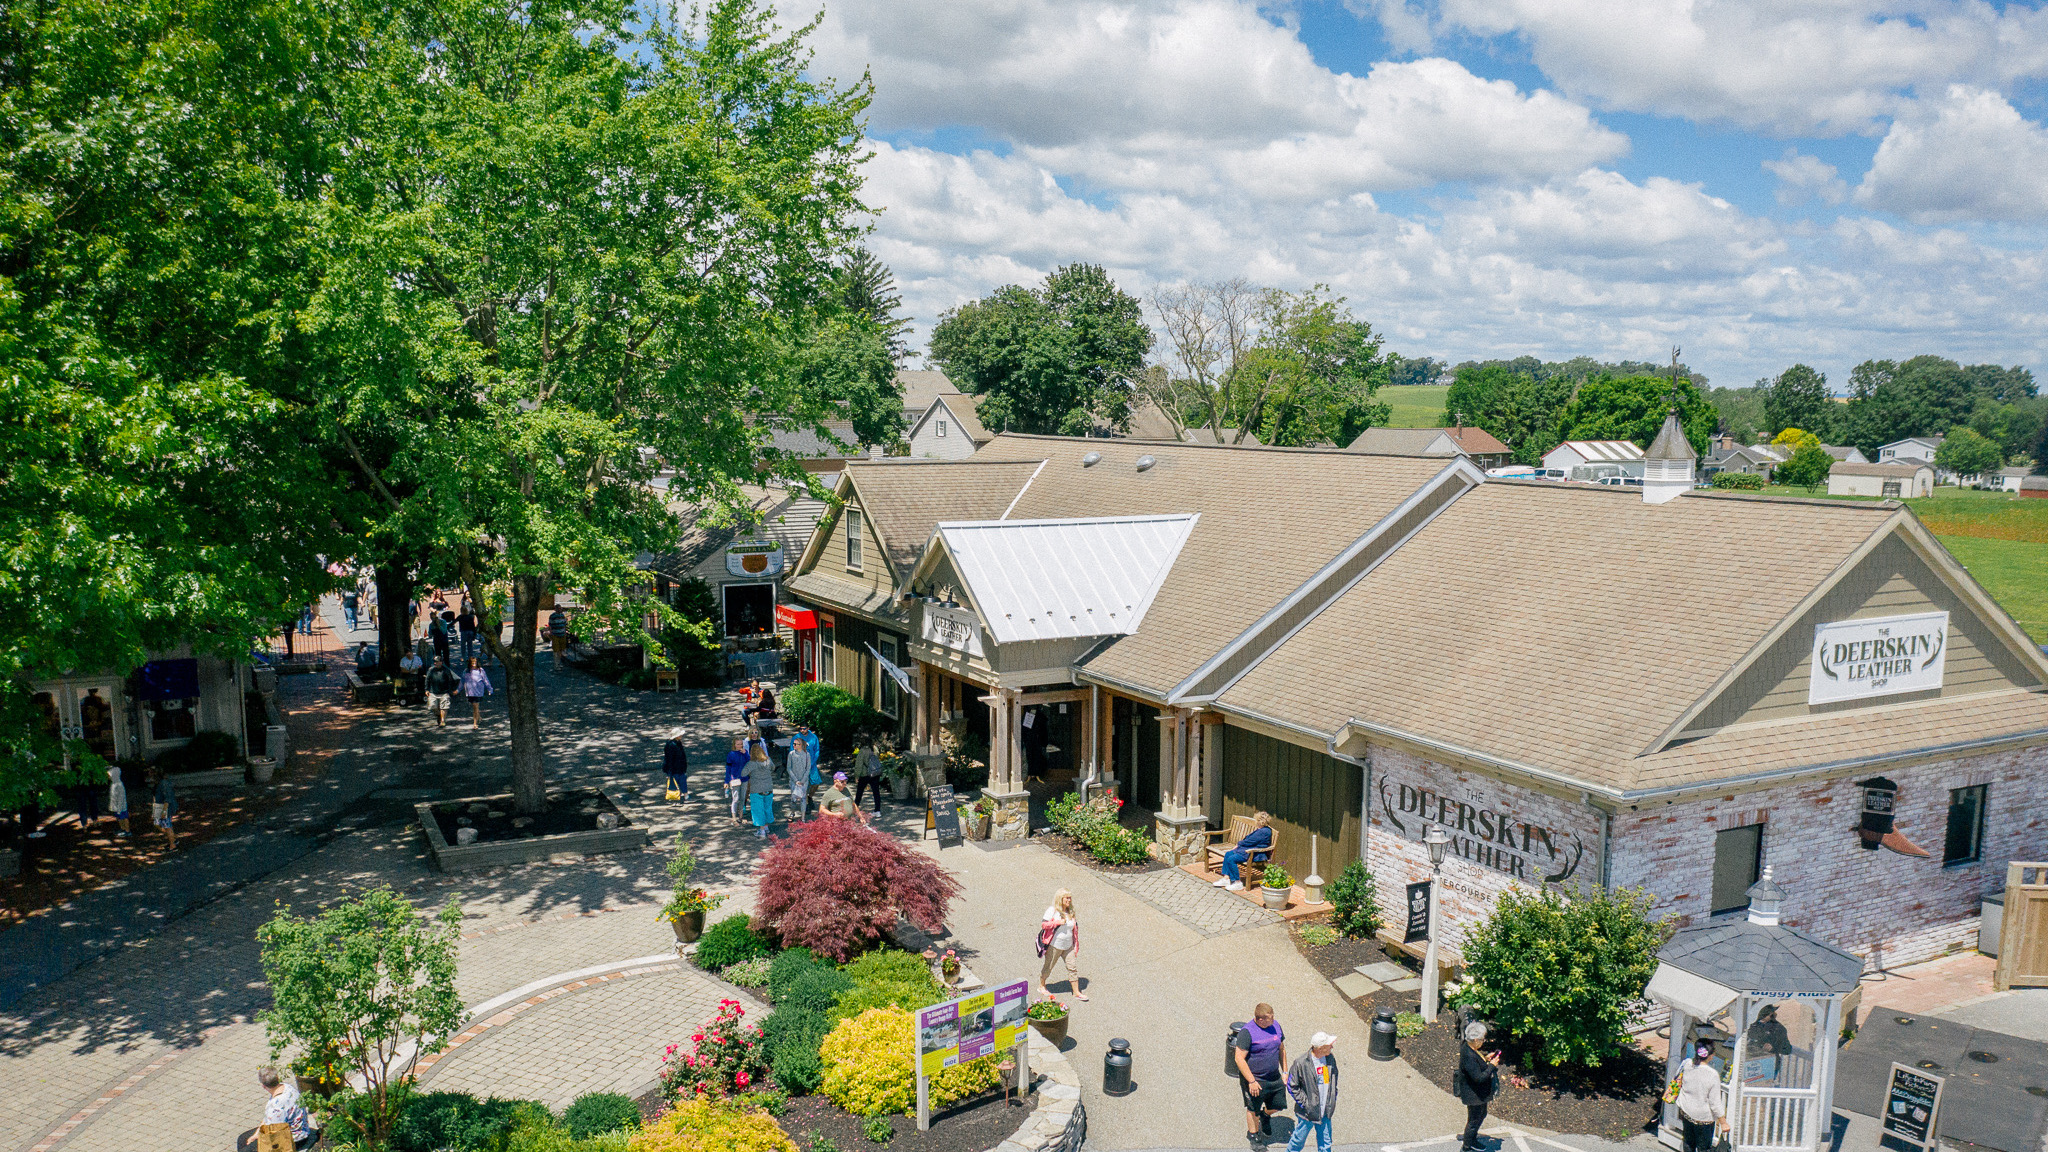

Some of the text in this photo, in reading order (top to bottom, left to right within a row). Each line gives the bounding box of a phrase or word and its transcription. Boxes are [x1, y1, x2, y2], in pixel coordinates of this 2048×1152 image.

[936, 616, 968, 635] DEERSKIN
[1878, 628, 1890, 636] THE
[941, 629, 962, 643] LEATHER
[1833, 634, 1931, 664] DEERSKIN
[1848, 659, 1912, 680] LEATHER
[1871, 678, 1887, 688] SHOP
[1466, 788, 1485, 804] THE
[1398, 783, 1557, 861] DEERSKIN
[1422, 823, 1525, 879] LATHER
[1458, 864, 1484, 879] SHOP
[981, 1046, 993, 1055] RIDE
[944, 1058, 957, 1067] RIDE
